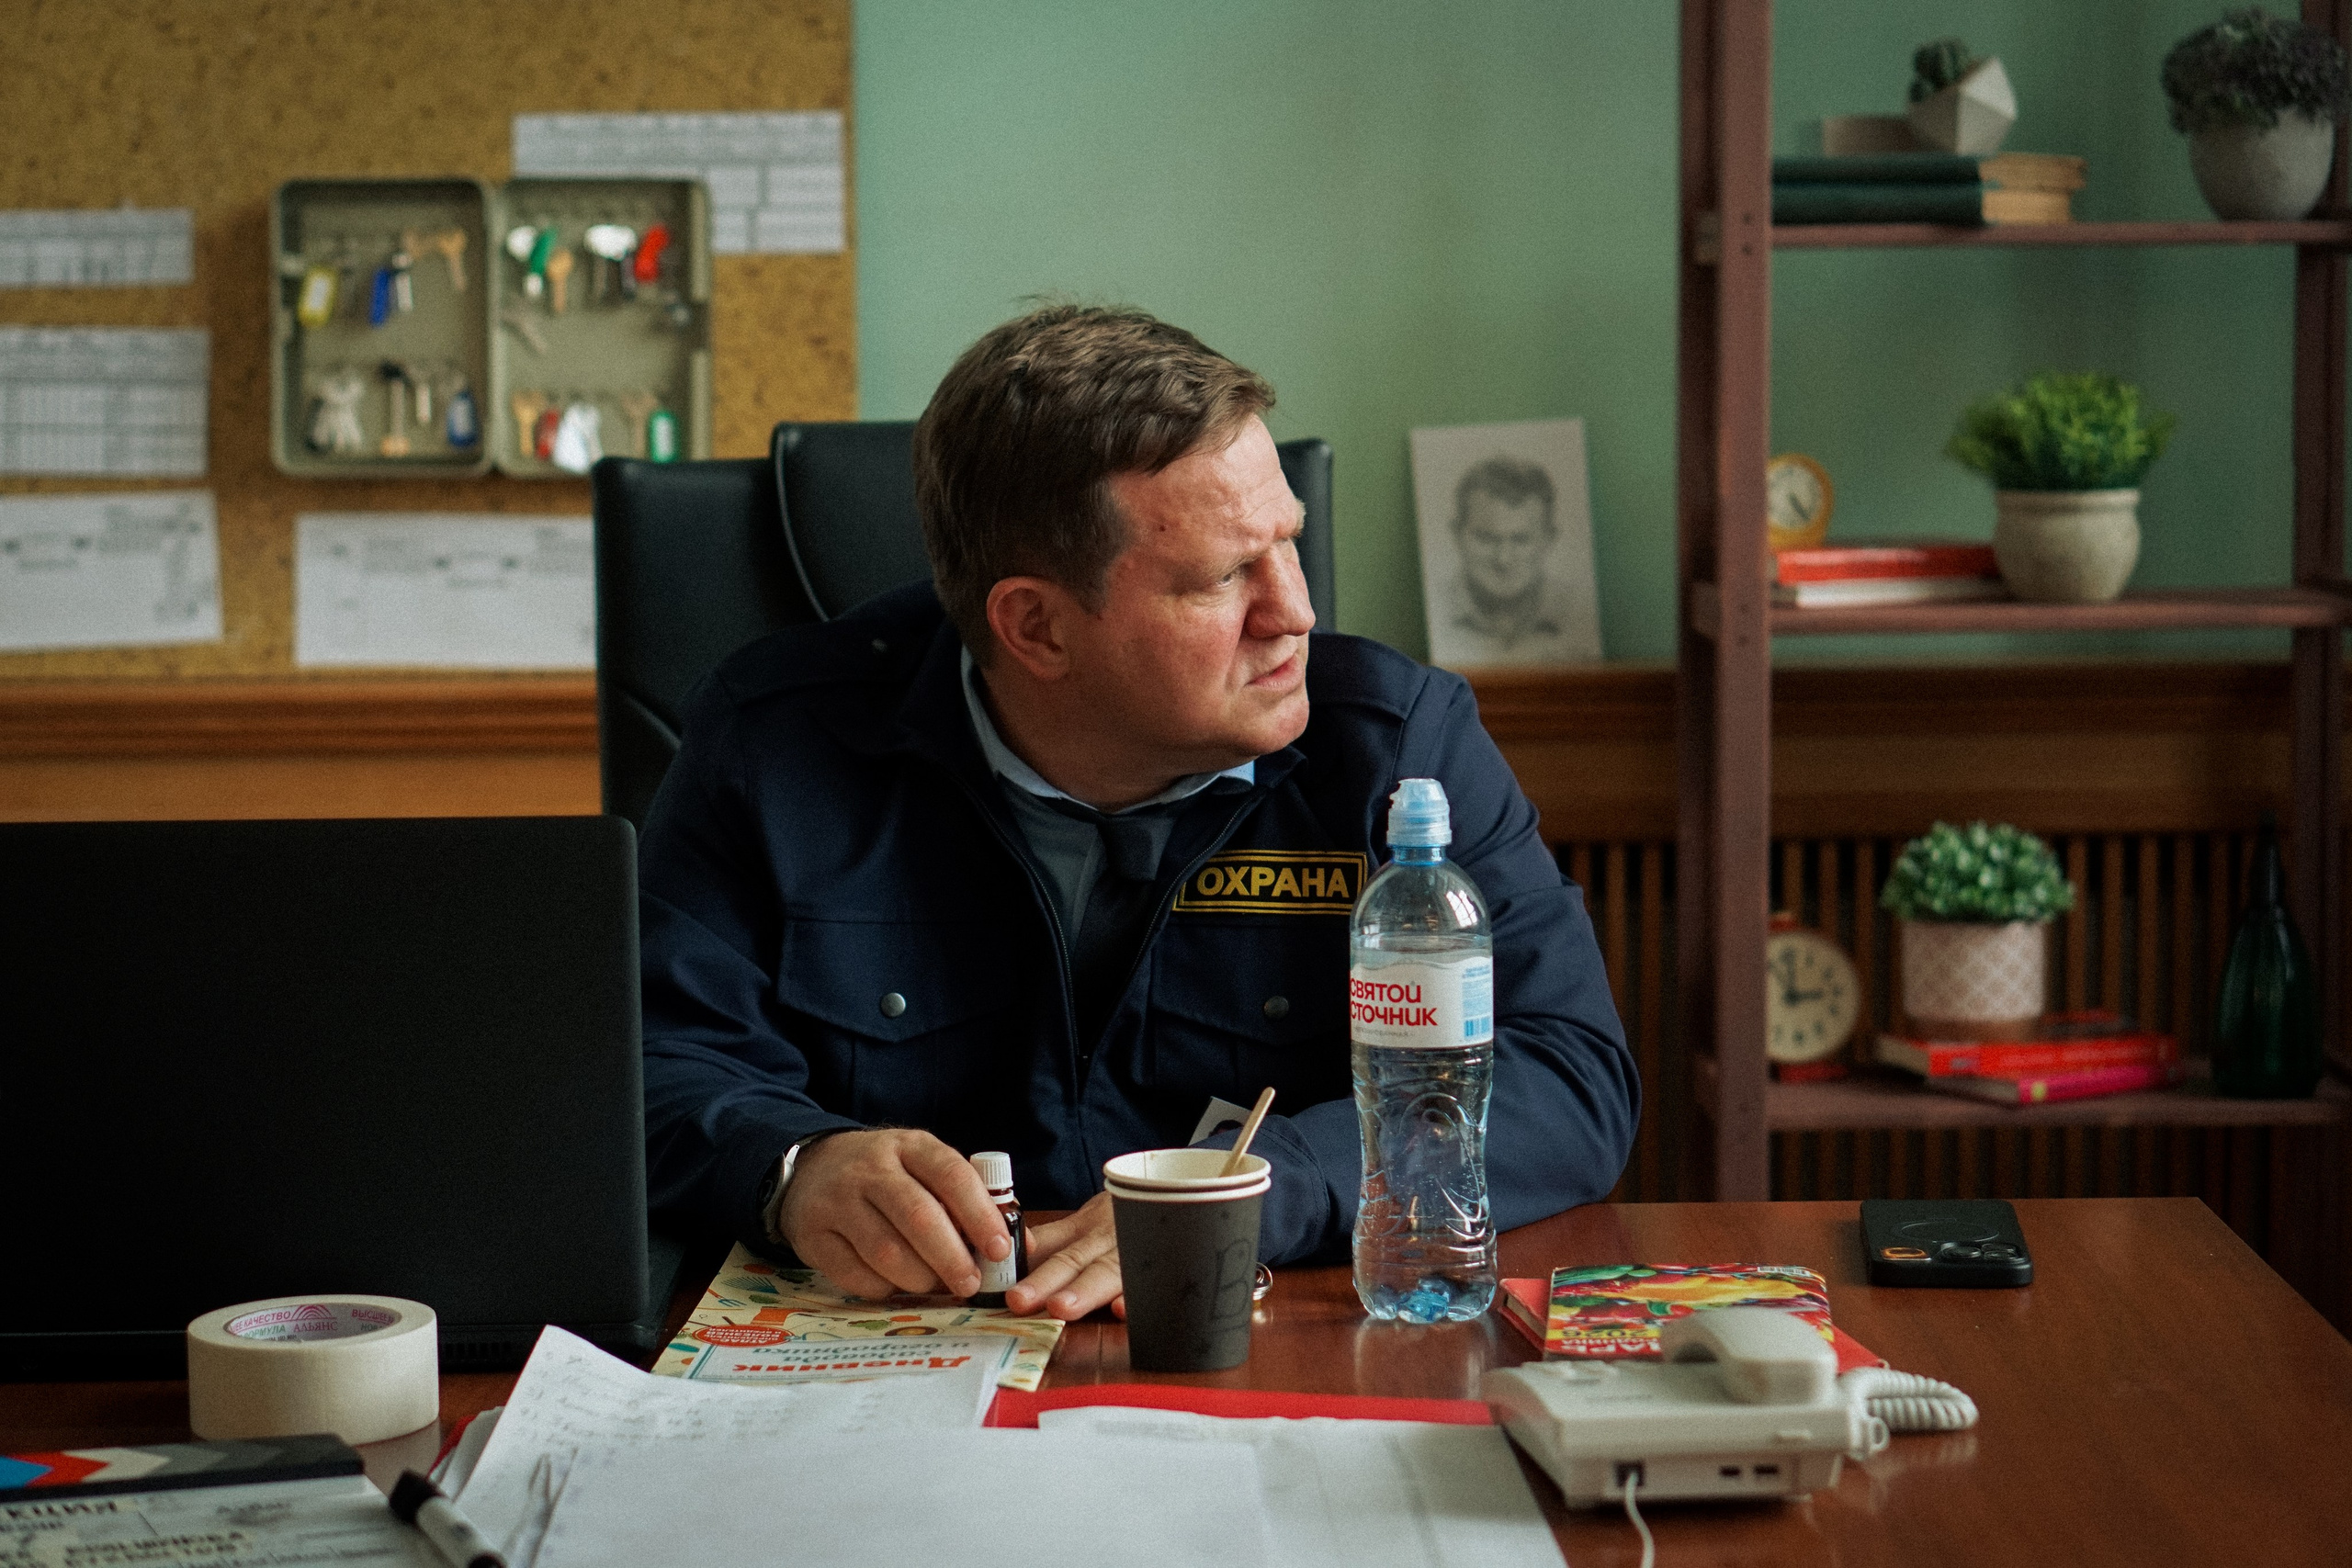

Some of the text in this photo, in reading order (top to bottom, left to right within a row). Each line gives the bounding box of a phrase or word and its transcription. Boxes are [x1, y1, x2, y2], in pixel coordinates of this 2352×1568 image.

[1196, 865, 1350, 898] ОХРАНА
[1351, 1000, 1438, 1027] СТОЧНИК
[243, 1311, 291, 1328] КАЧЕСТВО
[293, 1321, 338, 1333] АЛЬЯНС
[752, 1342, 942, 1355] огородника
[732, 1356, 971, 1371] Дневник
[784, 1350, 932, 1363] садовода
